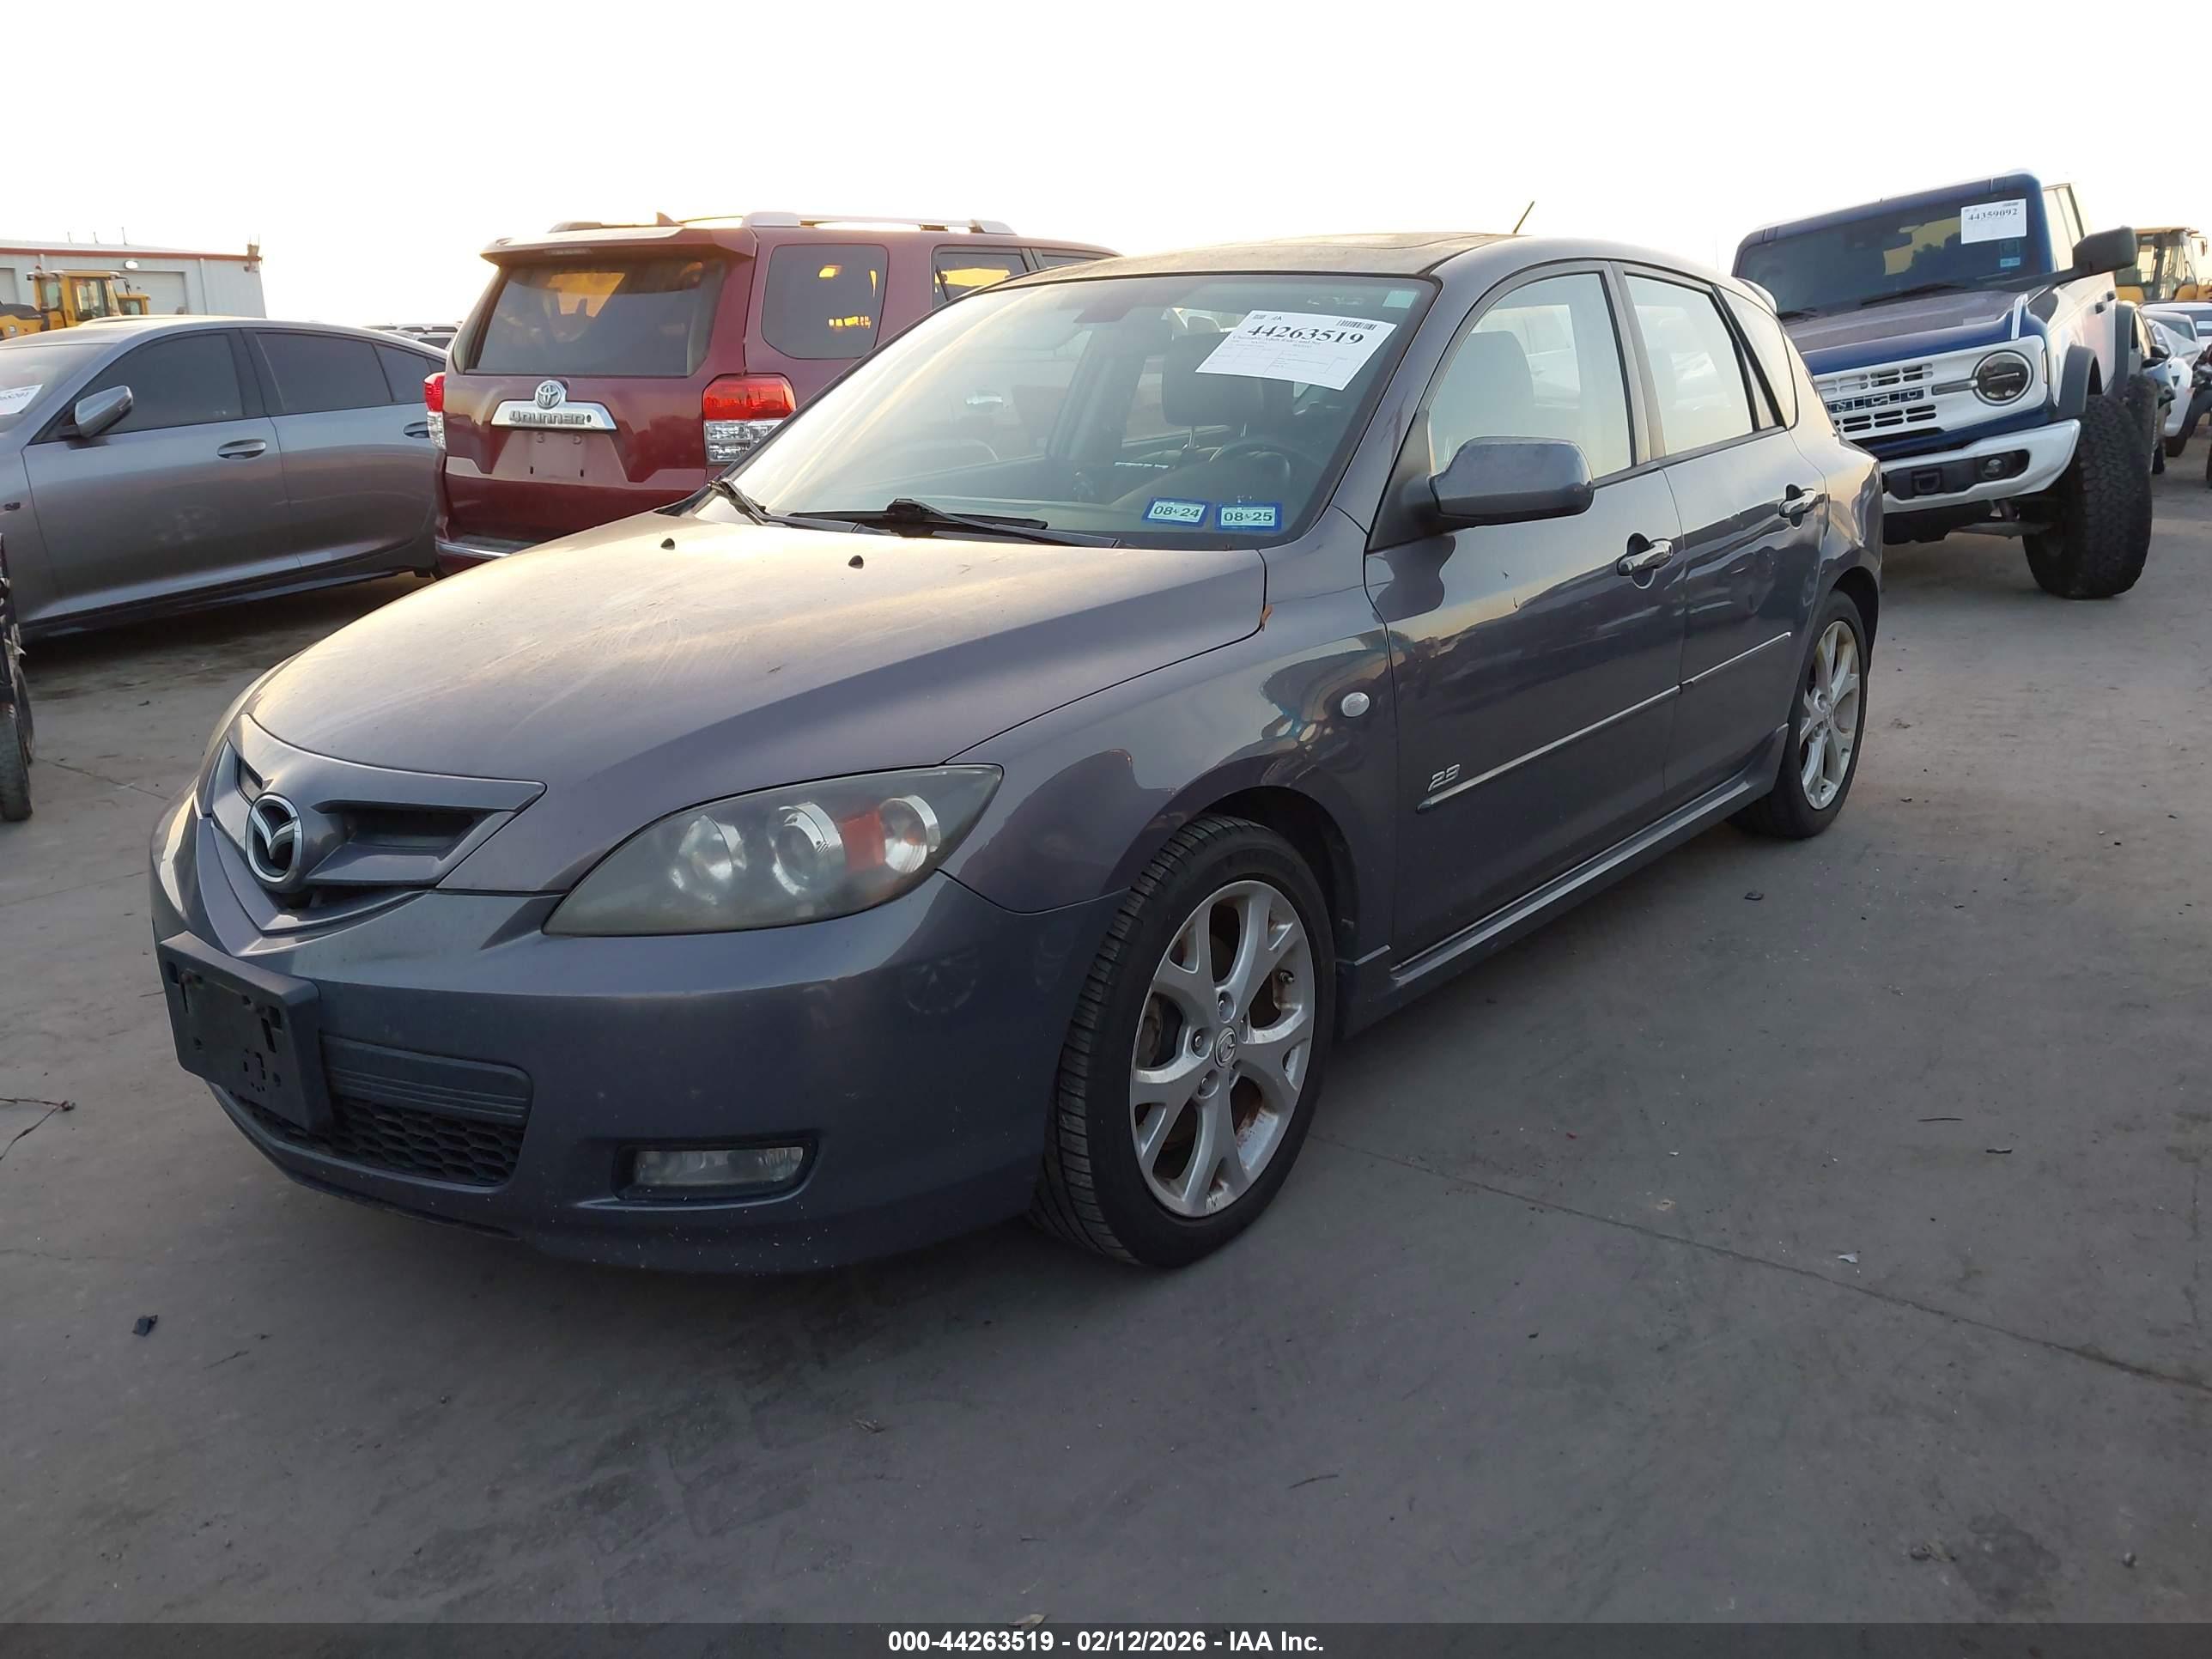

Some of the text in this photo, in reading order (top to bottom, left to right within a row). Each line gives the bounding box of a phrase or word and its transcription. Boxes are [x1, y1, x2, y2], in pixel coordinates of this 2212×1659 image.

[1968, 208, 2018, 221] 44359092
[1247, 324, 1364, 345] 44263519
[508, 410, 586, 425] 4RUNNER
